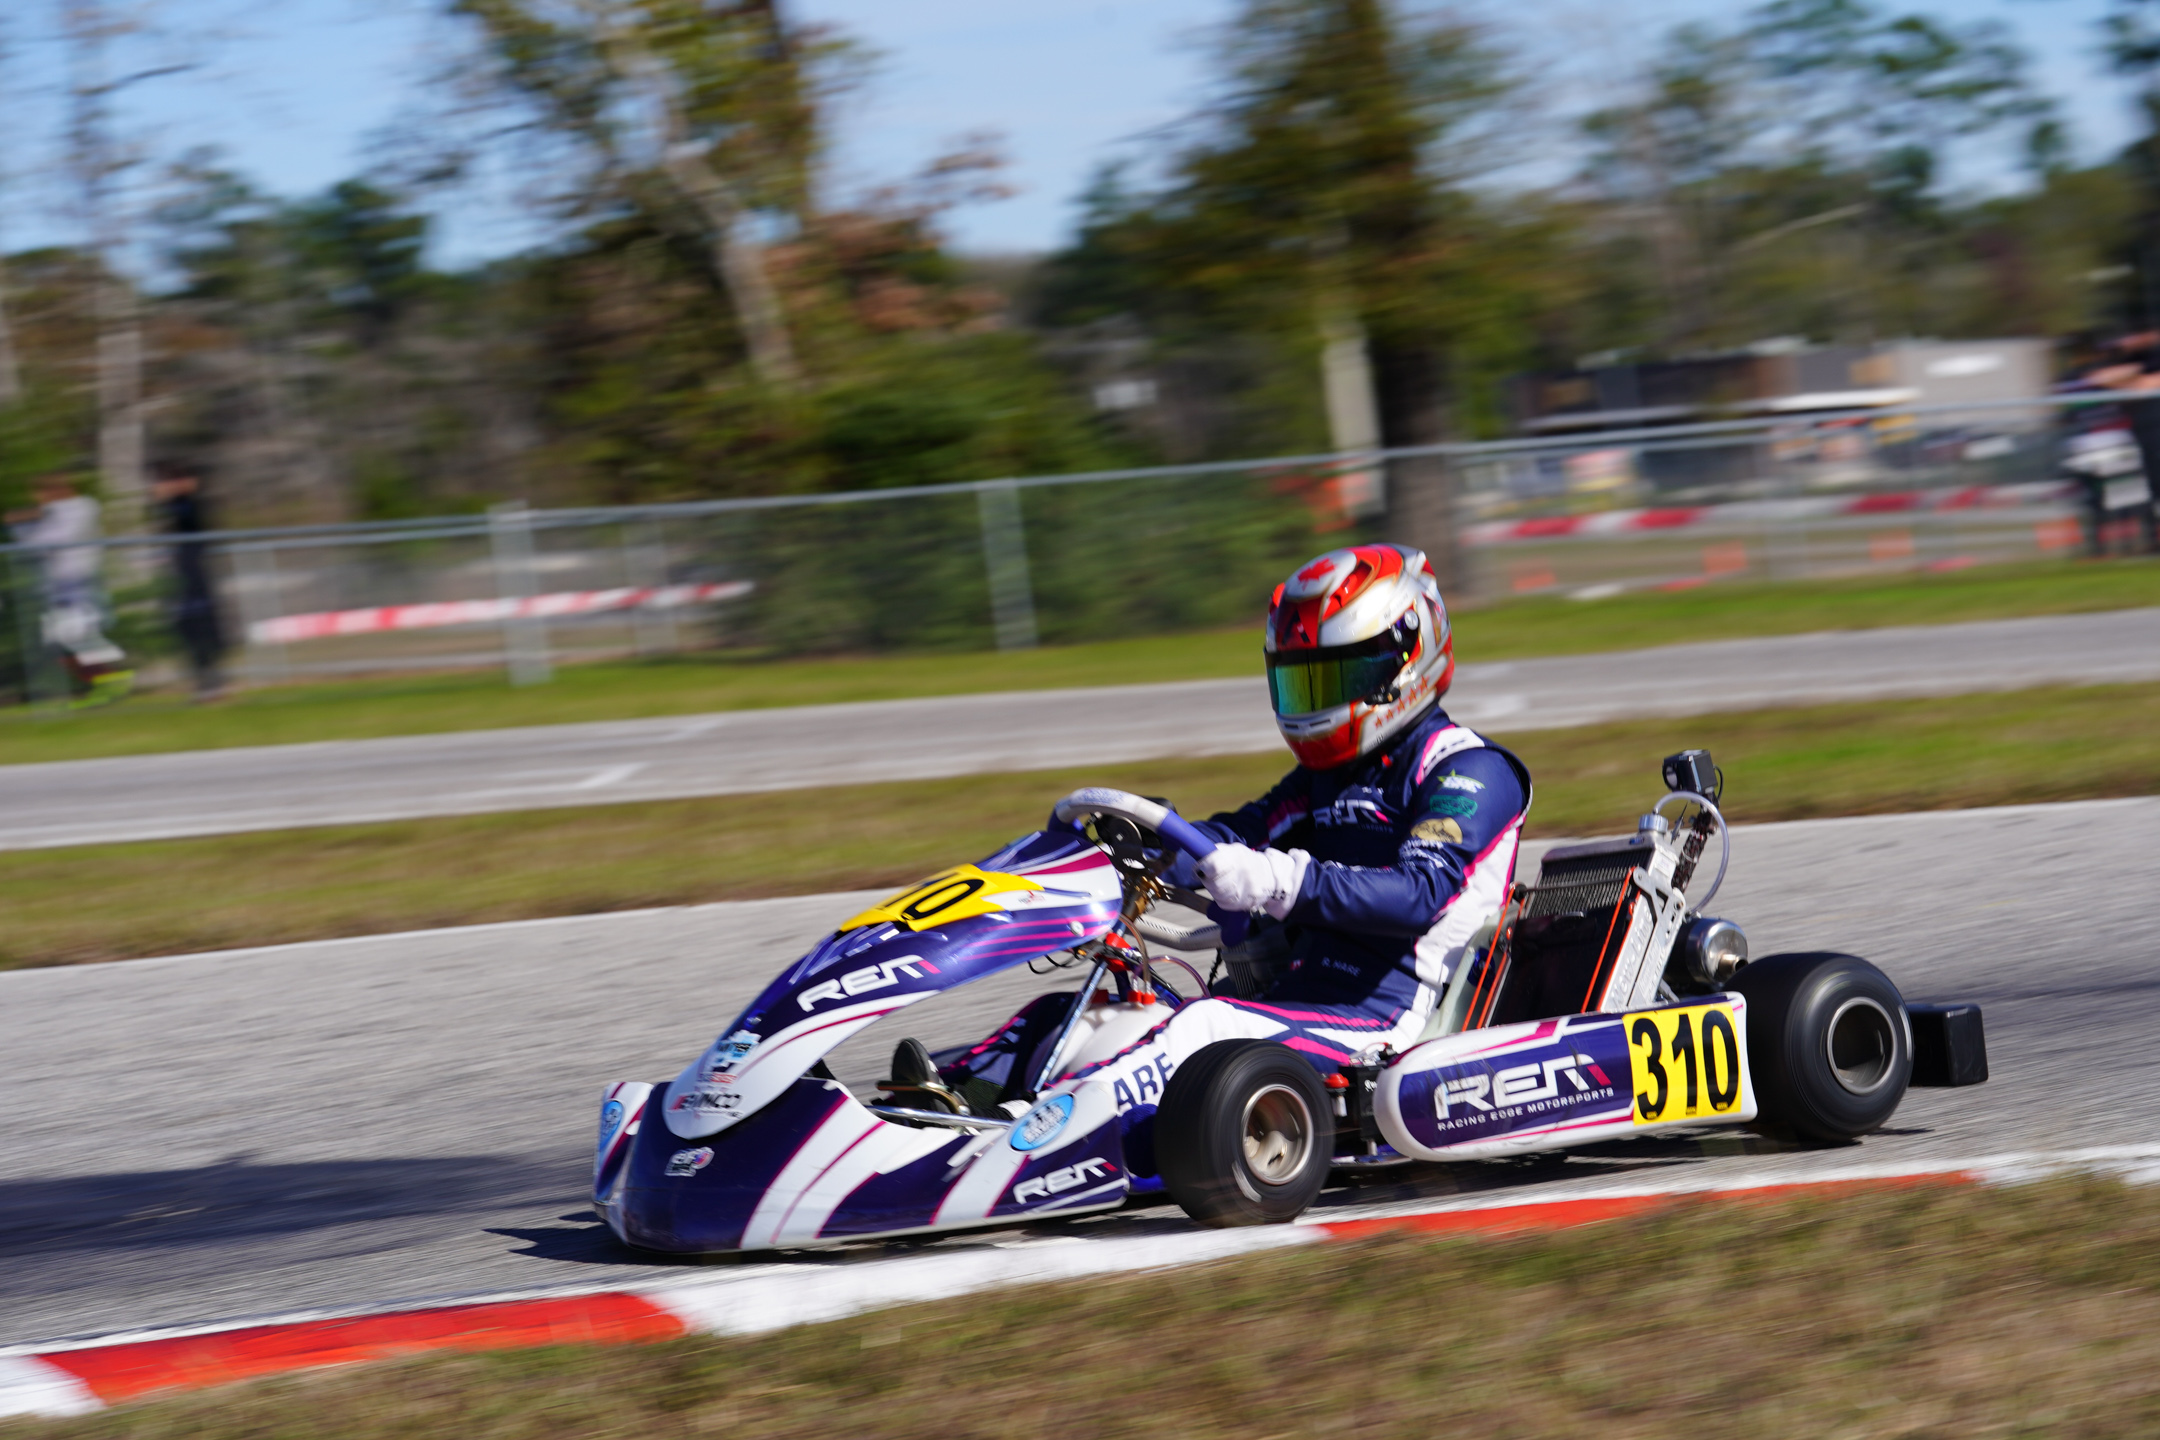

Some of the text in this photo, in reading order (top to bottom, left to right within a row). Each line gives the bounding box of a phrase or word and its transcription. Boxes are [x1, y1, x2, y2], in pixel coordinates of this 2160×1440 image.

[1631, 1009, 1739, 1121] 310
[1437, 1087, 1615, 1132] RACING EDGE MOTORSPORTS
